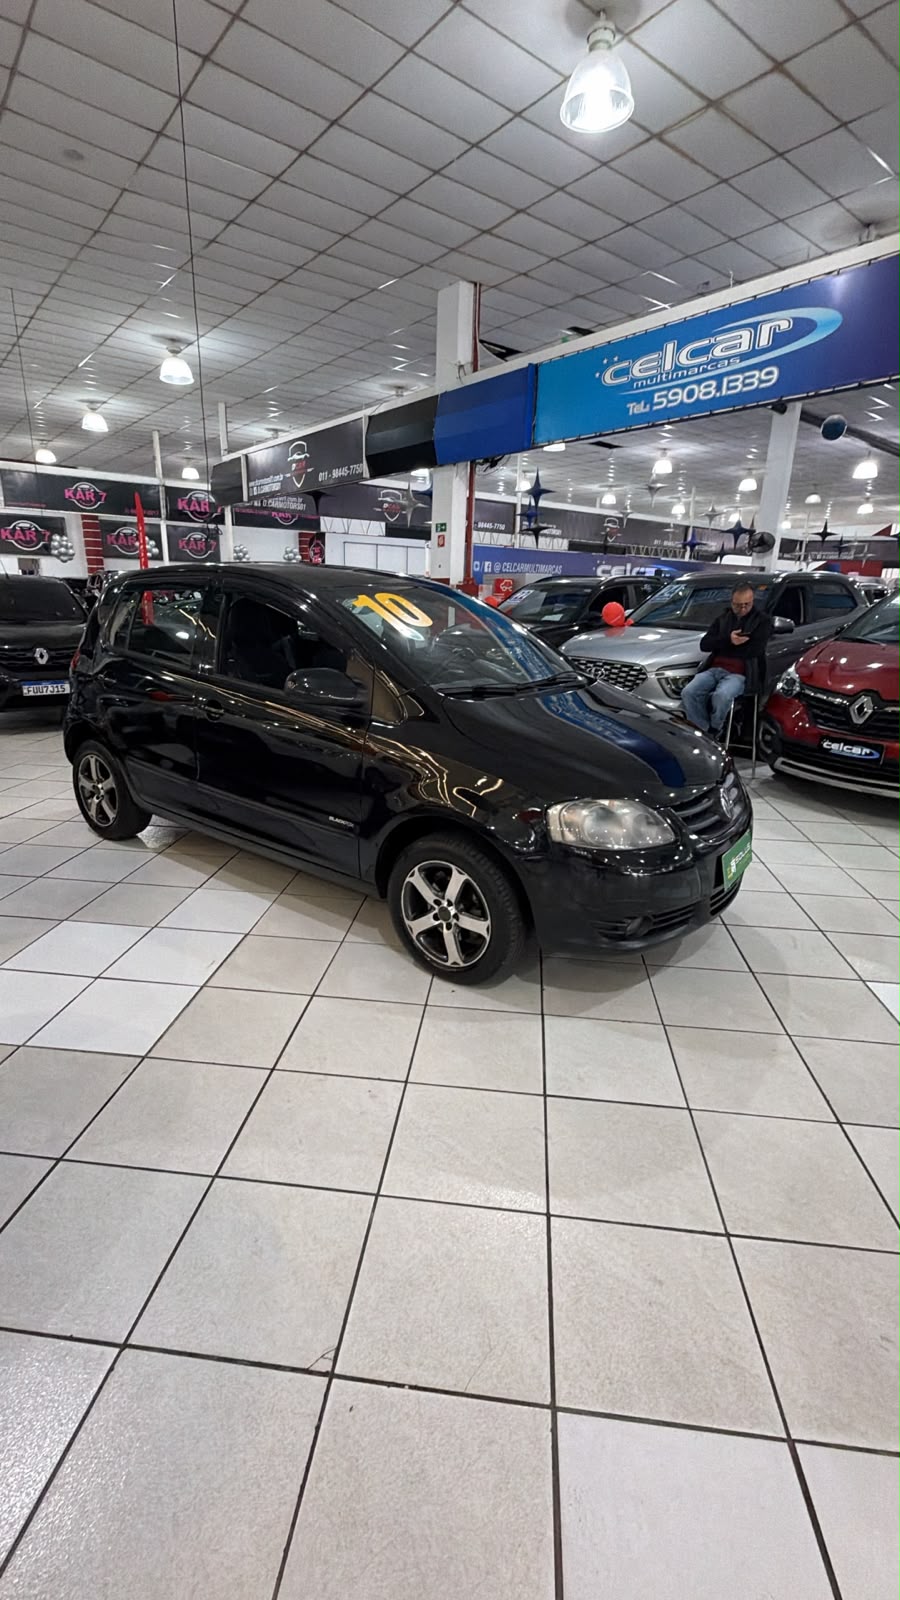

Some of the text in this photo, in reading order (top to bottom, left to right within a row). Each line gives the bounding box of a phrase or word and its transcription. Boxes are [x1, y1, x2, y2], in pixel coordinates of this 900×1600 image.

[602, 317, 793, 386] celcar
[633, 356, 741, 389] multimarcas
[652, 366, 779, 411] 5908.1339
[64, 488, 107, 503] KAR 7
[177, 498, 210, 513] KAR
[0, 528, 51, 542] KAR 7
[178, 539, 217, 551] KAR 7
[352, 592, 433, 641] 10
[27, 684, 66, 695] FUU7J15
[823, 741, 871, 755] celcar
